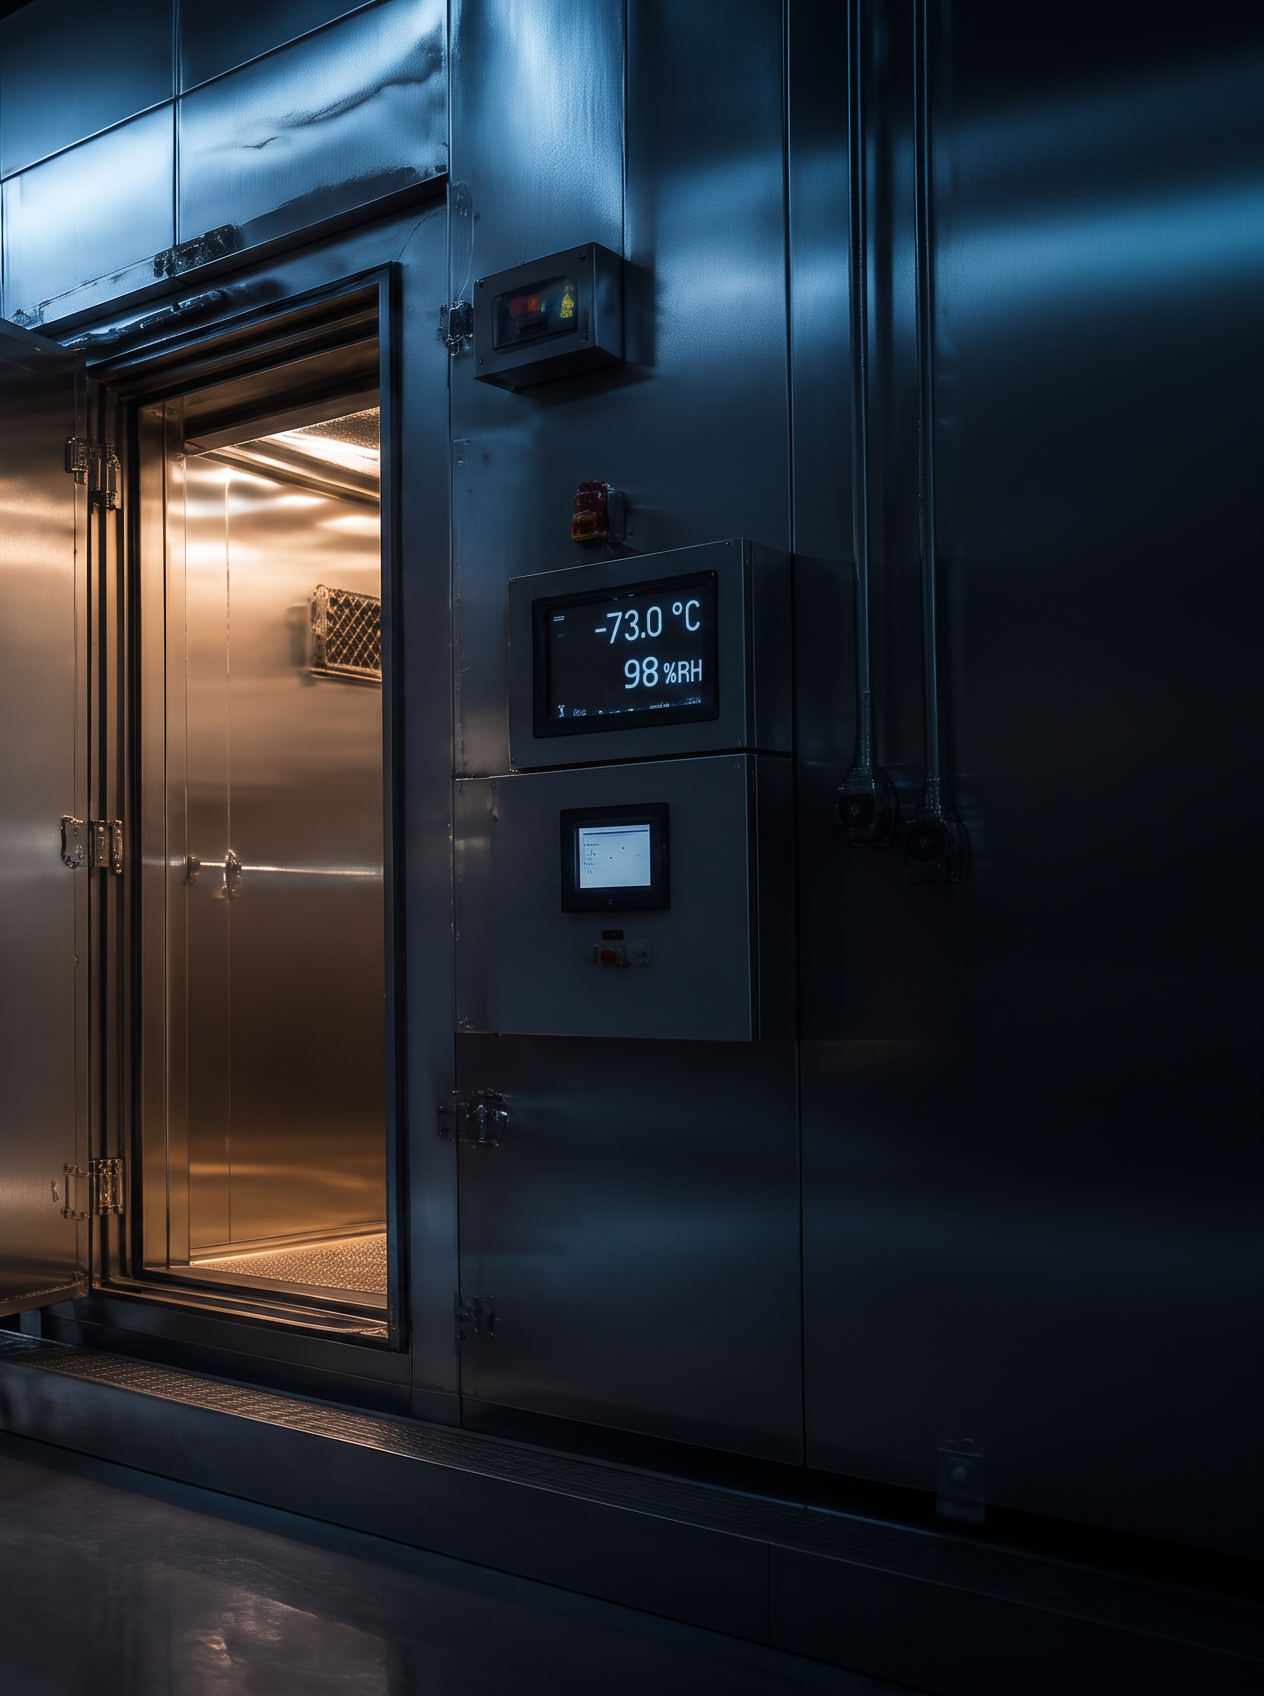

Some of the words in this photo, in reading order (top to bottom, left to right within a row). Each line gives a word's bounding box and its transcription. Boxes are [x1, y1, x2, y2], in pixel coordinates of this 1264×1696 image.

[594, 606, 662, 644] -73.0
[672, 600, 701, 632] °C
[624, 656, 659, 689] 98
[663, 659, 703, 684] %RH
